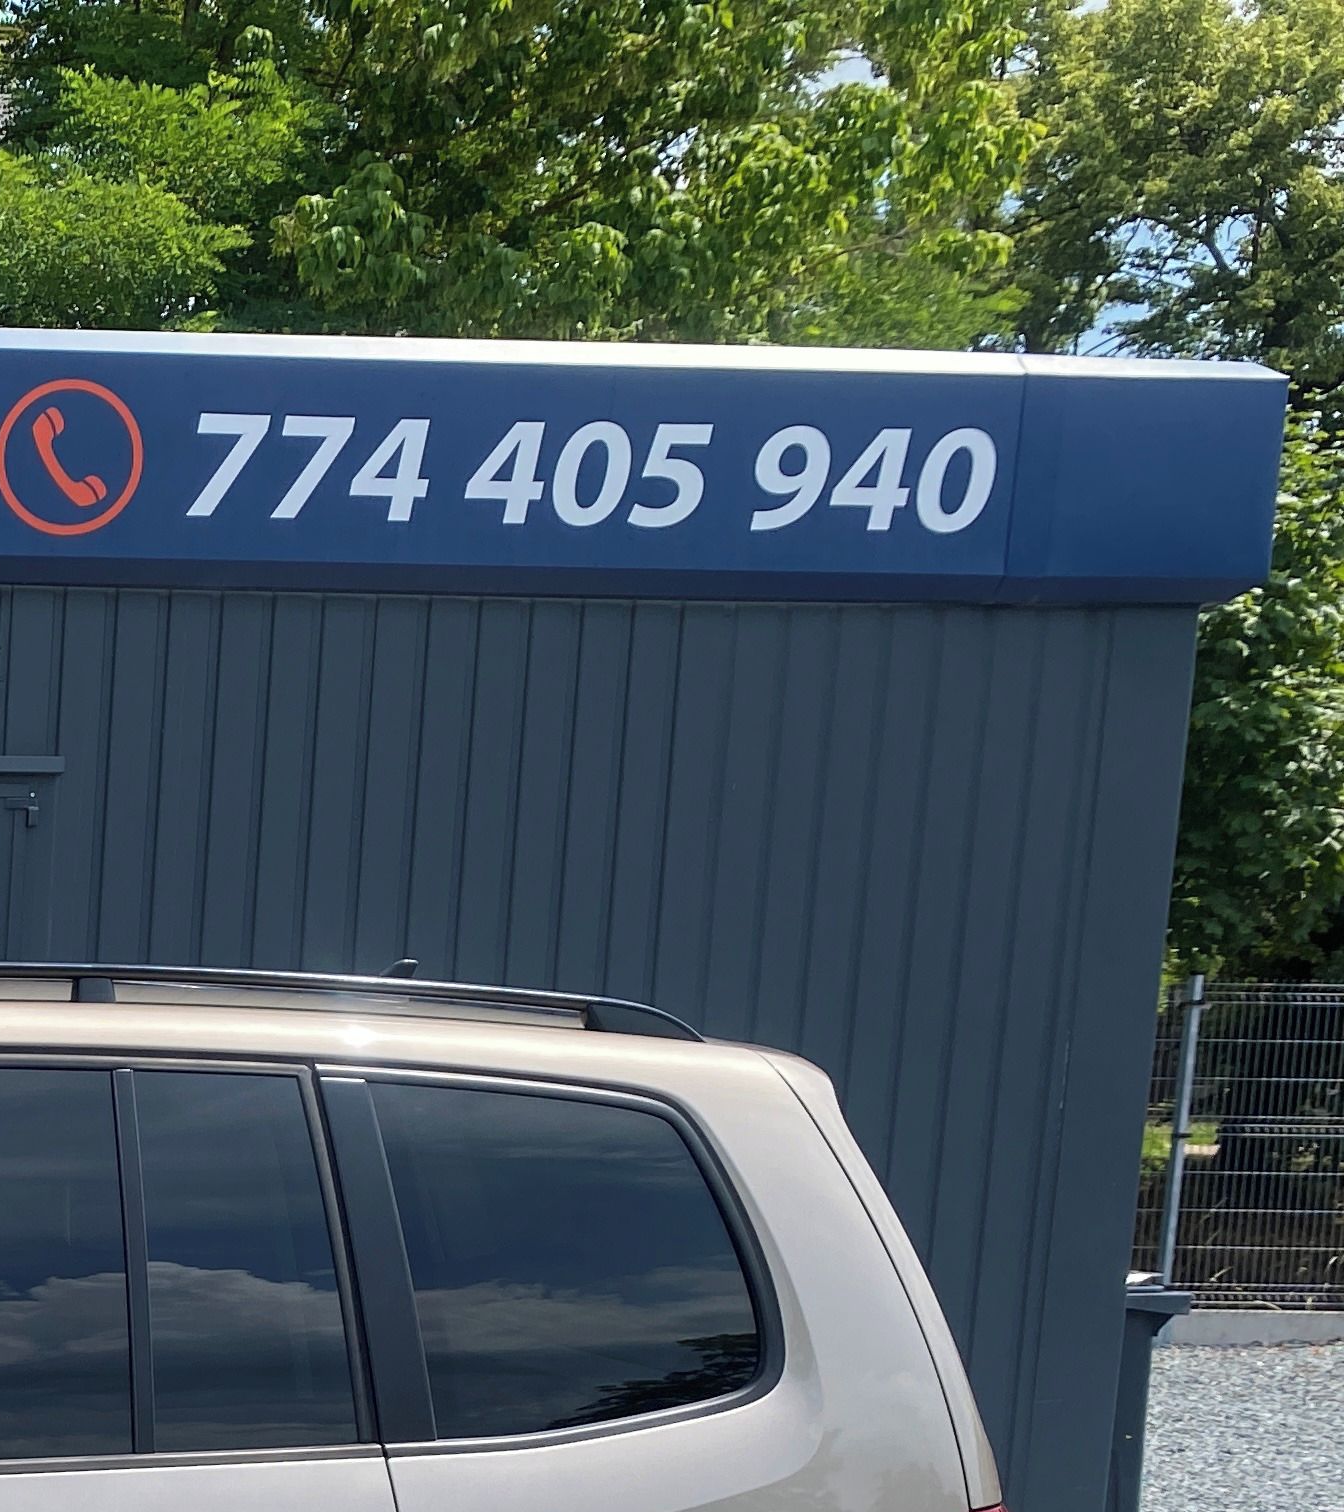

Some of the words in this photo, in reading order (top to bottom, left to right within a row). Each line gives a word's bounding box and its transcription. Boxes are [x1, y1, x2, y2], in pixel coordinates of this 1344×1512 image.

[186, 412, 431, 522] 774
[465, 421, 714, 528] 405
[750, 425, 997, 533] 940
